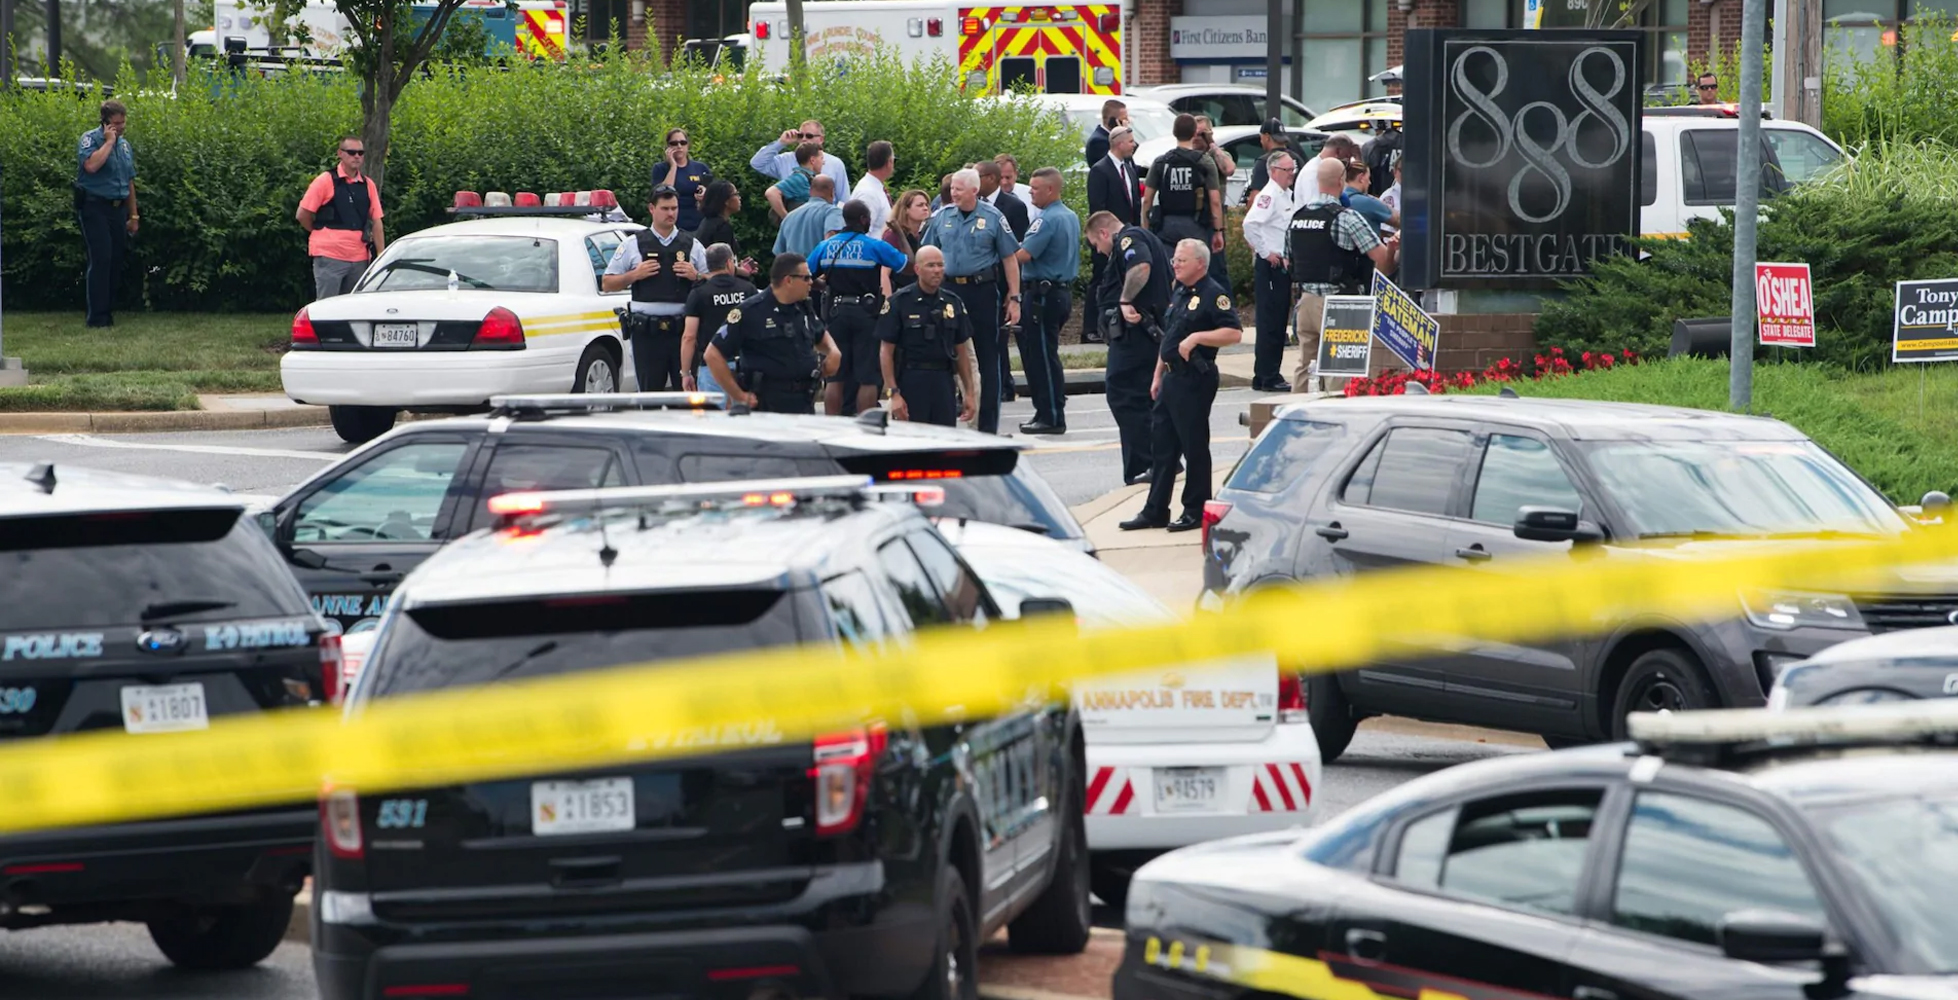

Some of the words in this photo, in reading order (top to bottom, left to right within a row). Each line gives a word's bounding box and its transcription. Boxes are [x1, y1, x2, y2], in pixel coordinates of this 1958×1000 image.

[1181, 29, 1201, 45] First
[1203, 28, 1243, 45] Citizens
[1245, 28, 1267, 44] Ban
[1448, 46, 1629, 223] 888
[1170, 167, 1193, 185] ATF
[1170, 183, 1193, 191] POLICE
[1290, 219, 1326, 230] POLICE
[713, 291, 745, 306] POLICE
[1758, 274, 1812, 318] O'SHEA
[1915, 287, 1958, 308] Tony
[1385, 284, 1436, 332] SHERIFF
[1900, 304, 1958, 331] Camp
[1382, 294, 1435, 352] BATEMAN
[1762, 323, 1781, 337] STATE
[1783, 324, 1812, 338] DELEGATE
[387, 330, 415, 341] 84760
[1324, 328, 1369, 344] FREDERICKS
[1336, 344, 1368, 359] SHERIFF
[311, 595, 364, 616] ANNE
[241, 622, 310, 648] PATROL
[2, 632, 104, 661] POLICE
[1083, 690, 1176, 711] ANNAPOLIS
[1181, 690, 1215, 709] FIRE
[376, 799, 428, 828] 591
